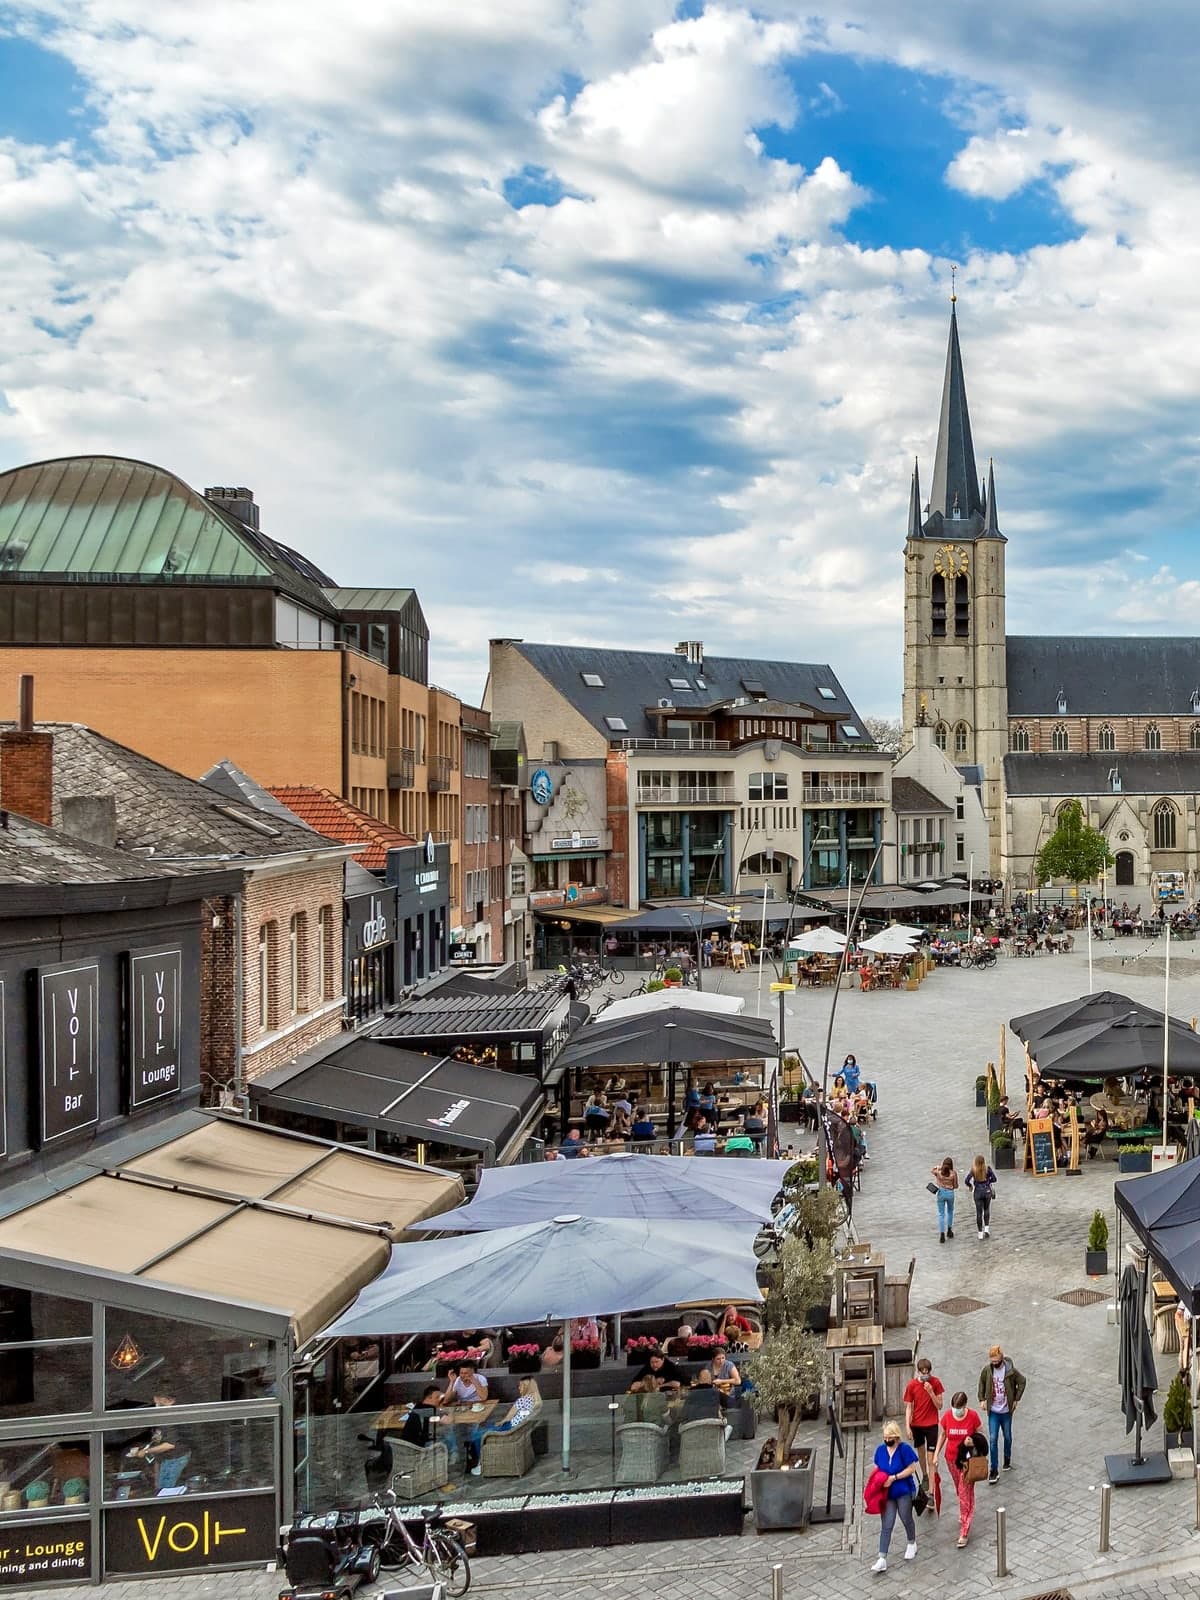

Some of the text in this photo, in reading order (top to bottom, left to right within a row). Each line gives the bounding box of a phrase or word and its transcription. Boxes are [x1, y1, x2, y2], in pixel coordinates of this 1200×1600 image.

[142, 1063, 176, 1086] Lounge
[64, 1093, 83, 1112] Bar
[25, 1541, 85, 1557] Lounge
[28, 1559, 49, 1571] and
[51, 1556, 85, 1568] dining
